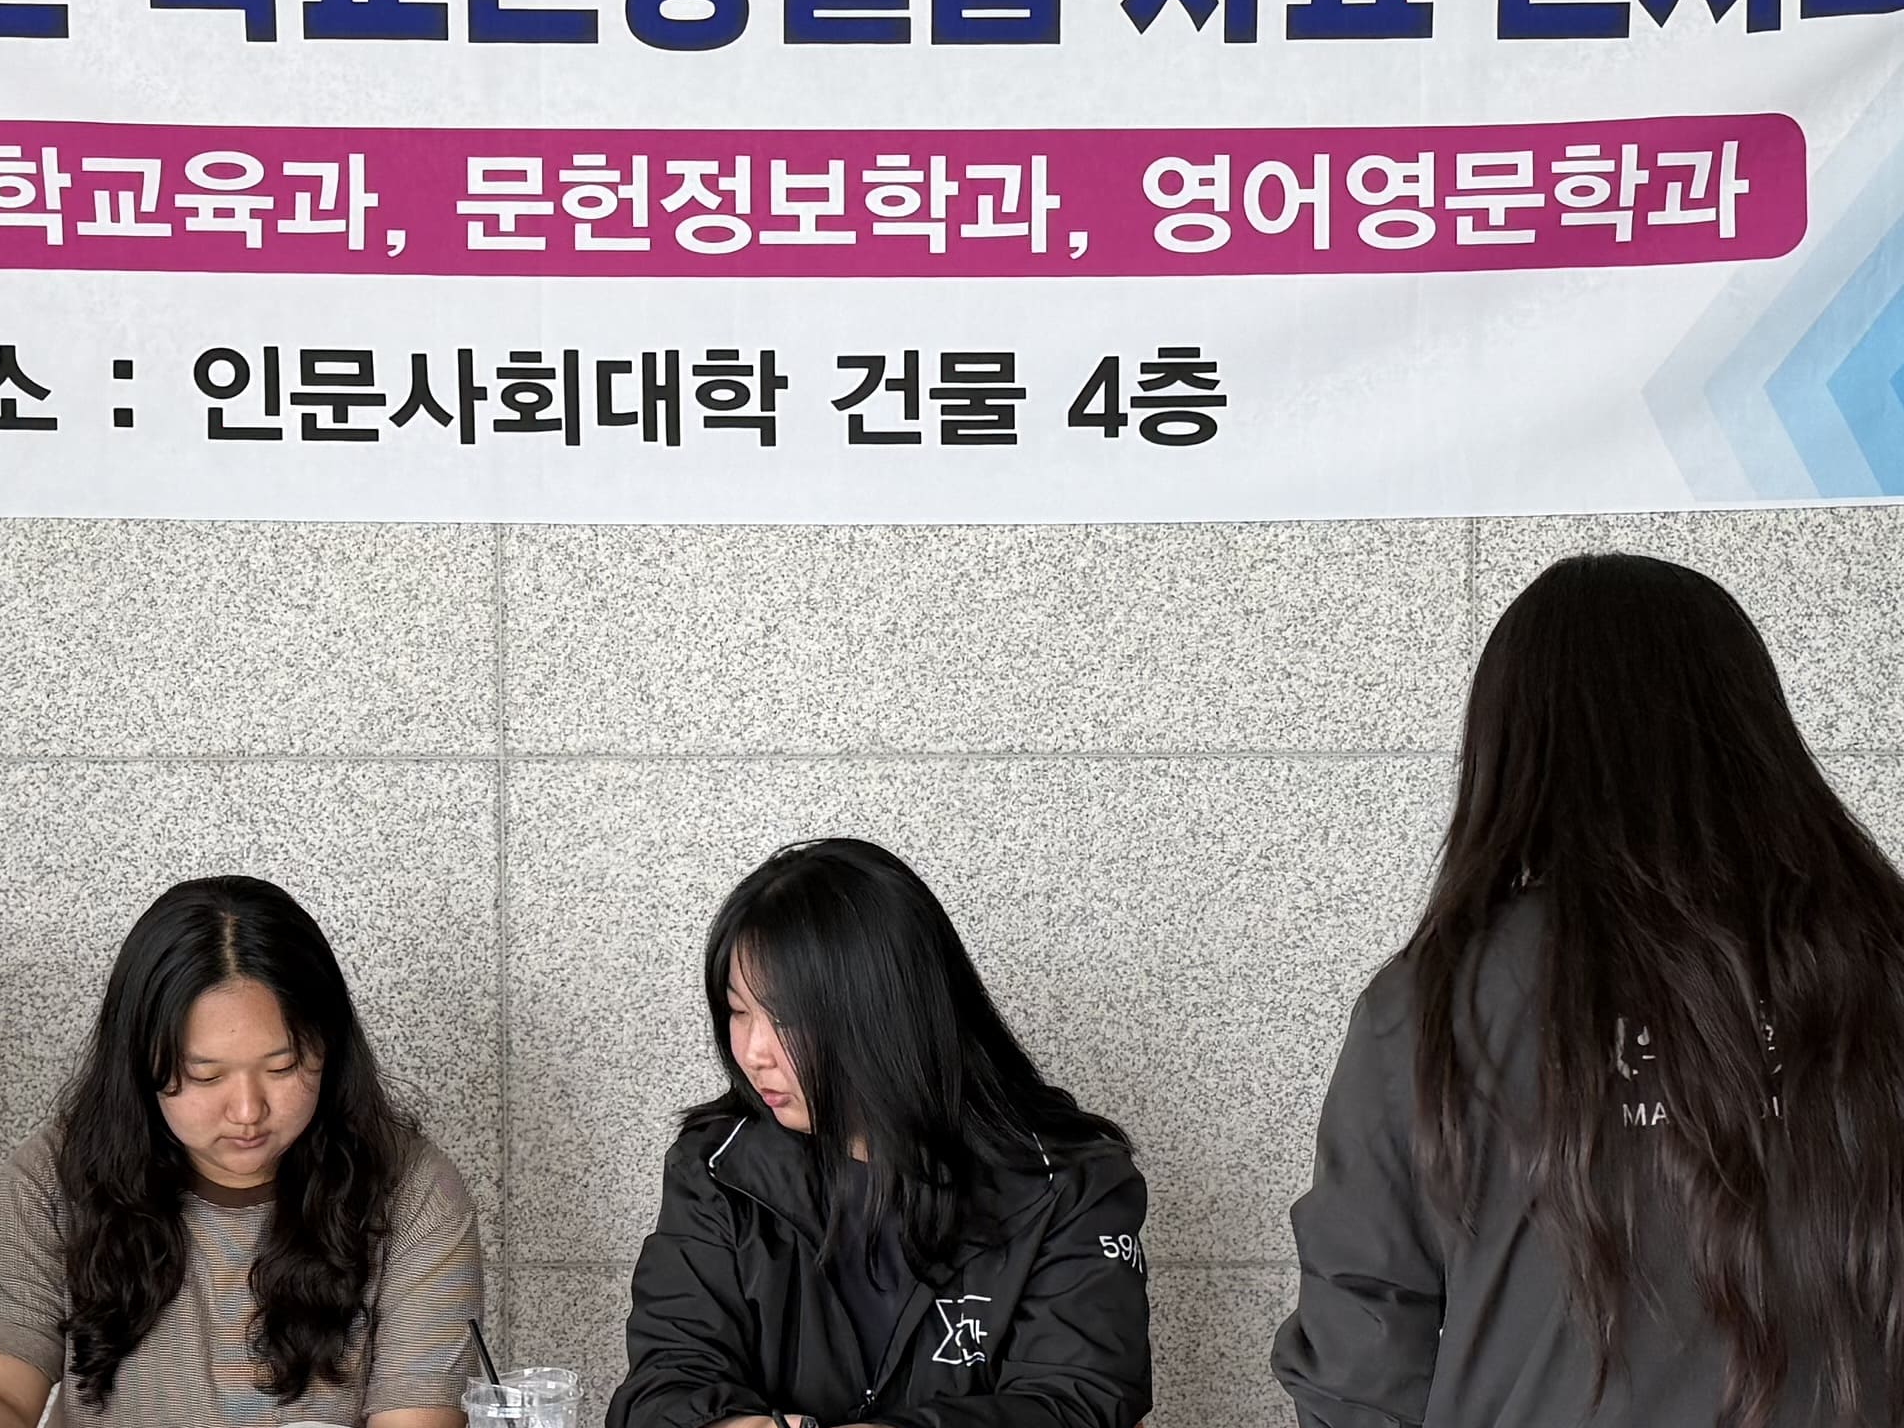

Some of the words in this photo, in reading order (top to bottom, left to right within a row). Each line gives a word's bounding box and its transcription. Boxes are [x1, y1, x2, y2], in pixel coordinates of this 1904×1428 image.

[457, 155, 1087, 259] 문헌정보학과,
[1143, 141, 1749, 252] 영어영문학과
[194, 347, 788, 446] 인문사회대학
[831, 350, 1026, 445] 건물
[1068, 347, 1226, 446] 4층
